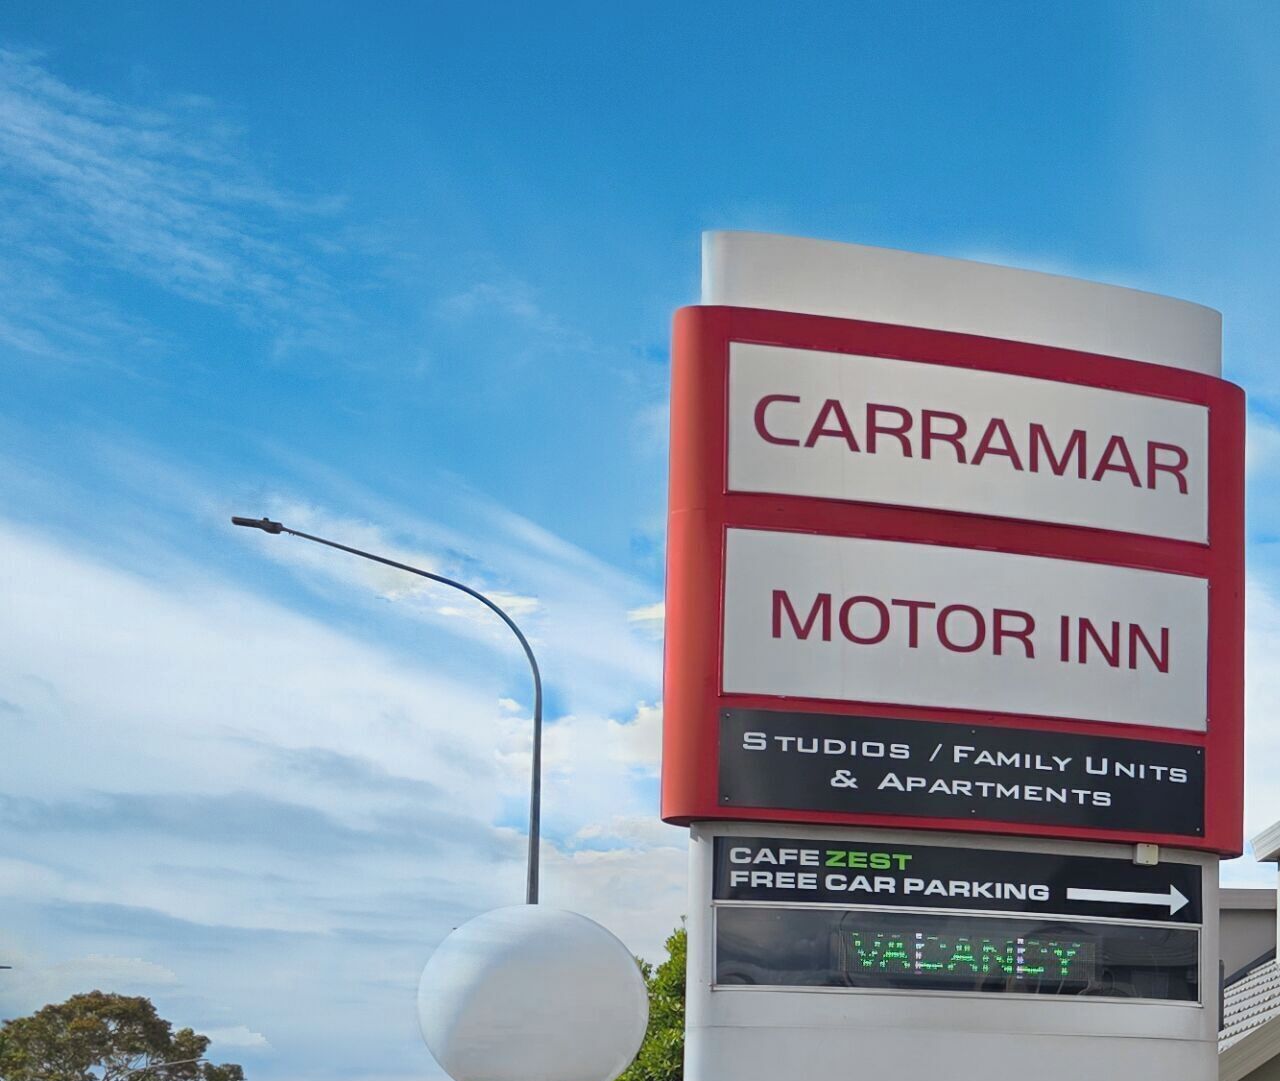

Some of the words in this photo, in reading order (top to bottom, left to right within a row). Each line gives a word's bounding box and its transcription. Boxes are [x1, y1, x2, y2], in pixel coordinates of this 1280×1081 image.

[754, 394, 1189, 494] CARRAMAR
[771, 589, 1036, 660] MOTOR
[1060, 614, 1170, 674] INN
[742, 731, 911, 760] STUDIOS
[1085, 756, 1188, 784] UNITS
[830, 769, 858, 788] &
[877, 771, 1112, 807] APARTMENTS
[729, 847, 820, 866] CAFE
[825, 850, 913, 870] ZEST
[729, 870, 818, 890] FREE
[824, 874, 895, 894] CAR
[903, 879, 1050, 902] PARKING
[852, 932, 1080, 979] VACANCY
